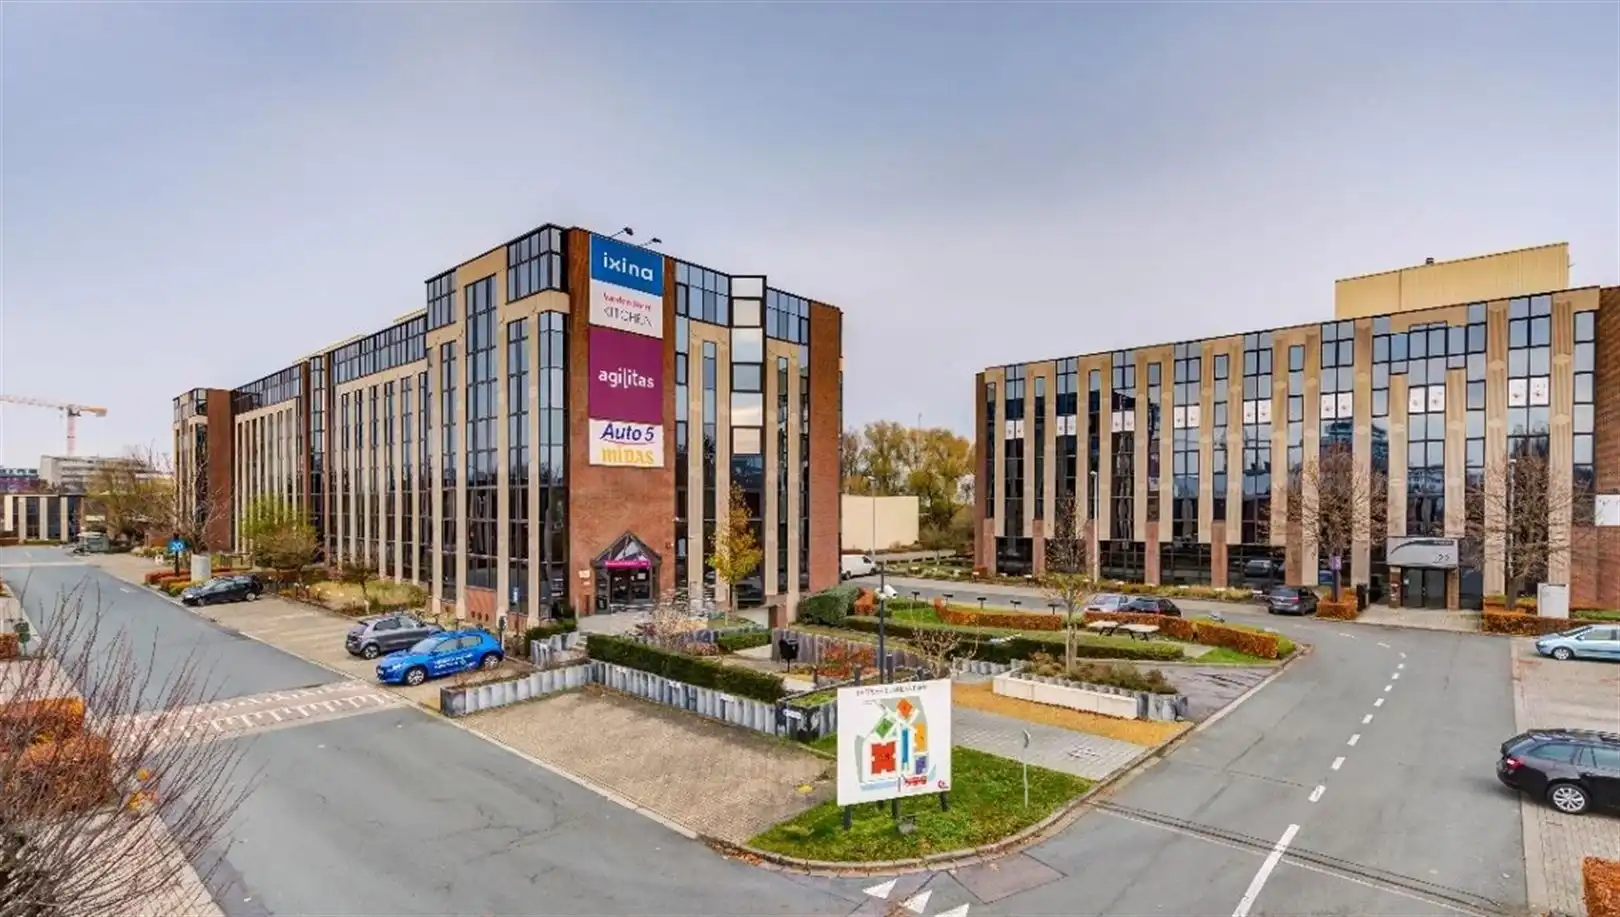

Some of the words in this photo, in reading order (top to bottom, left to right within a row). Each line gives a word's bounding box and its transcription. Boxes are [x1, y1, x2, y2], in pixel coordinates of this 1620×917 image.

[603, 251, 653, 281] ixina
[603, 306, 653, 328] KITCHEN
[598, 367, 655, 389] agilitas
[599, 422, 642, 441] Auto
[644, 426, 655, 442] 5
